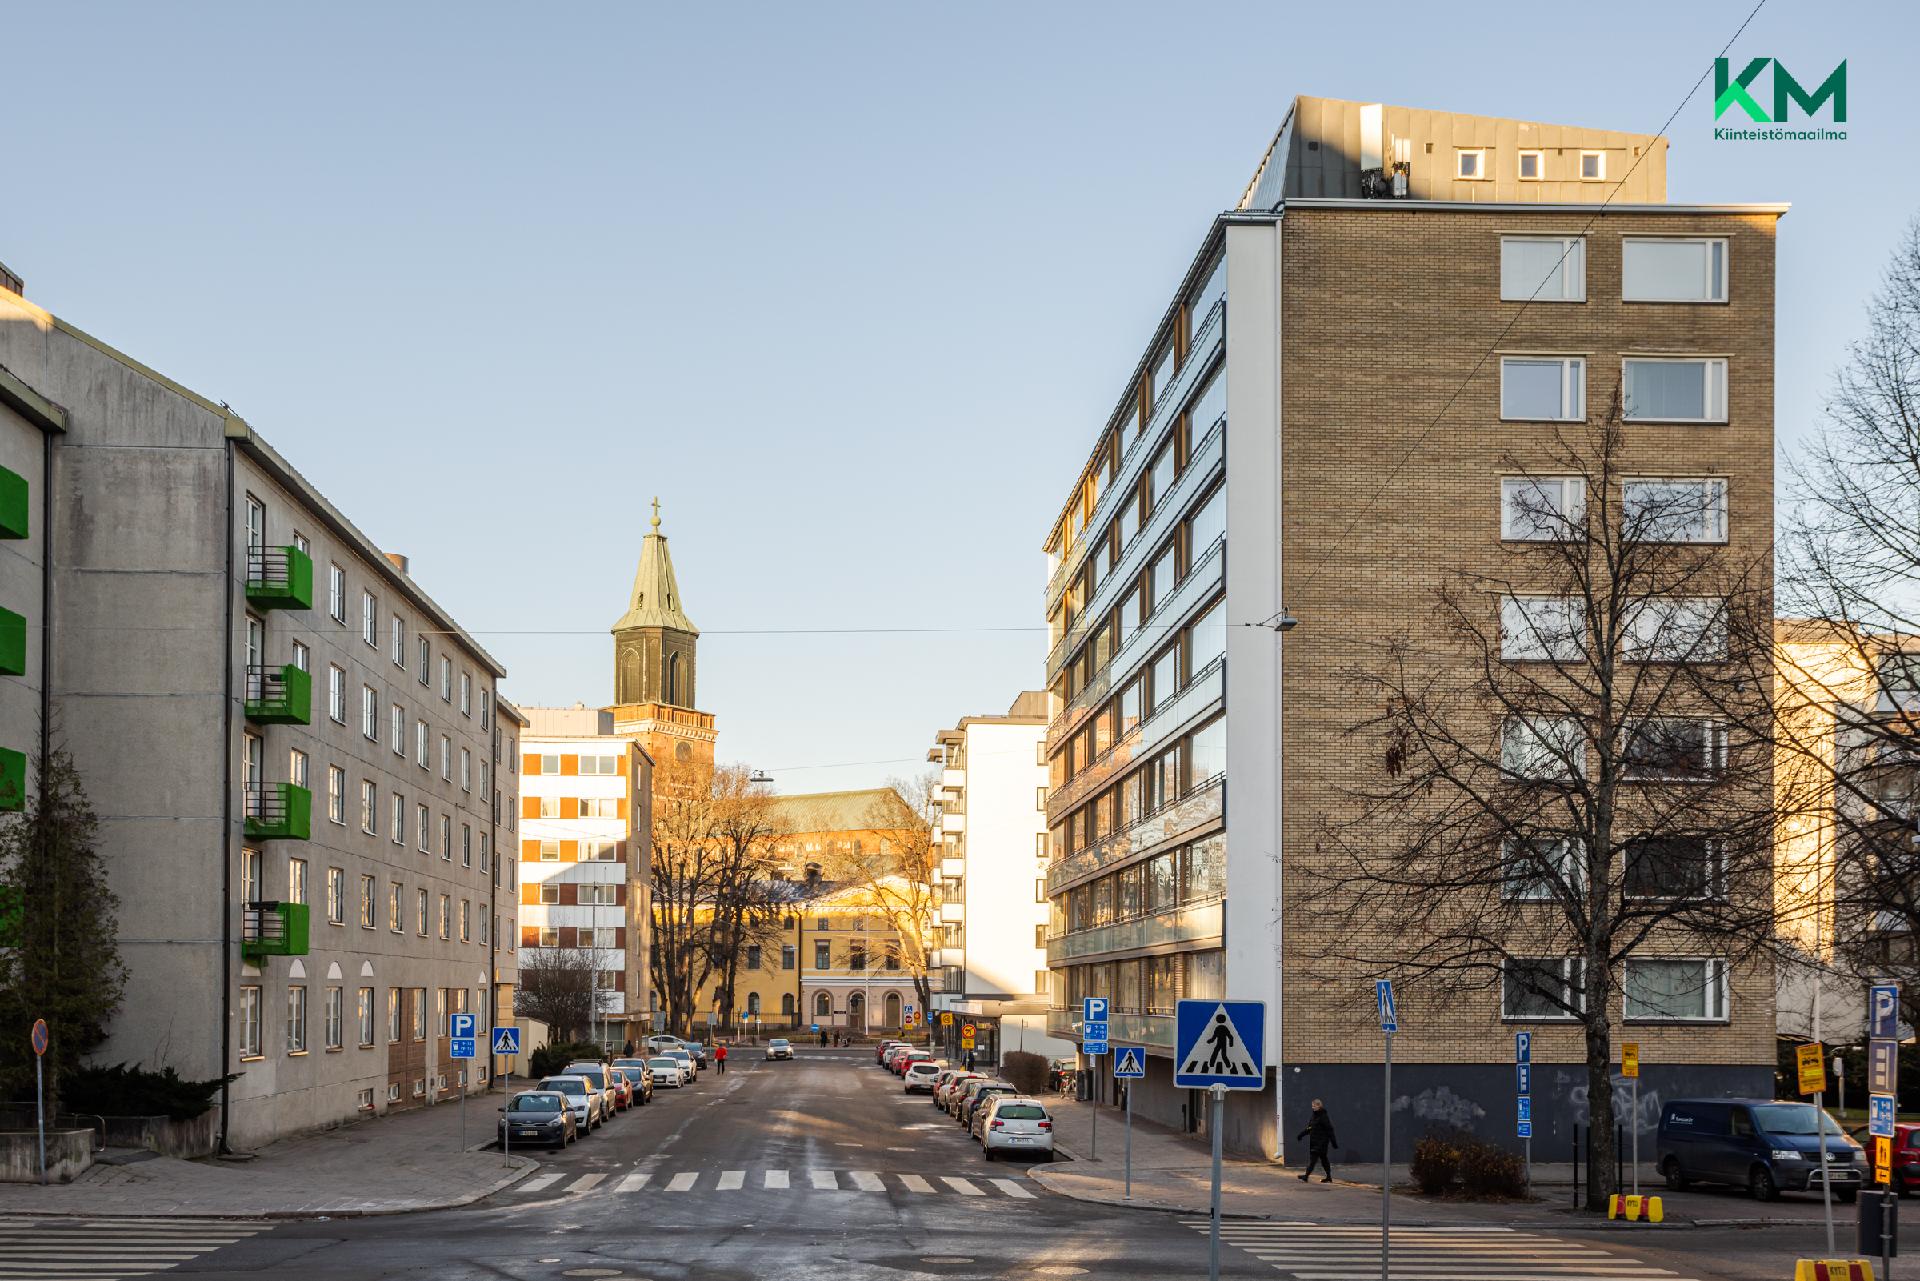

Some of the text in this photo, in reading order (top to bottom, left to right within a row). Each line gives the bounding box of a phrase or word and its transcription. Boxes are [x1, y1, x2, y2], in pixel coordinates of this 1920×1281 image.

[1090, 1000, 1105, 1020] P
[1876, 990, 1894, 1035] P
[456, 1015, 472, 1037] P
[1518, 1034, 1528, 1061] P
